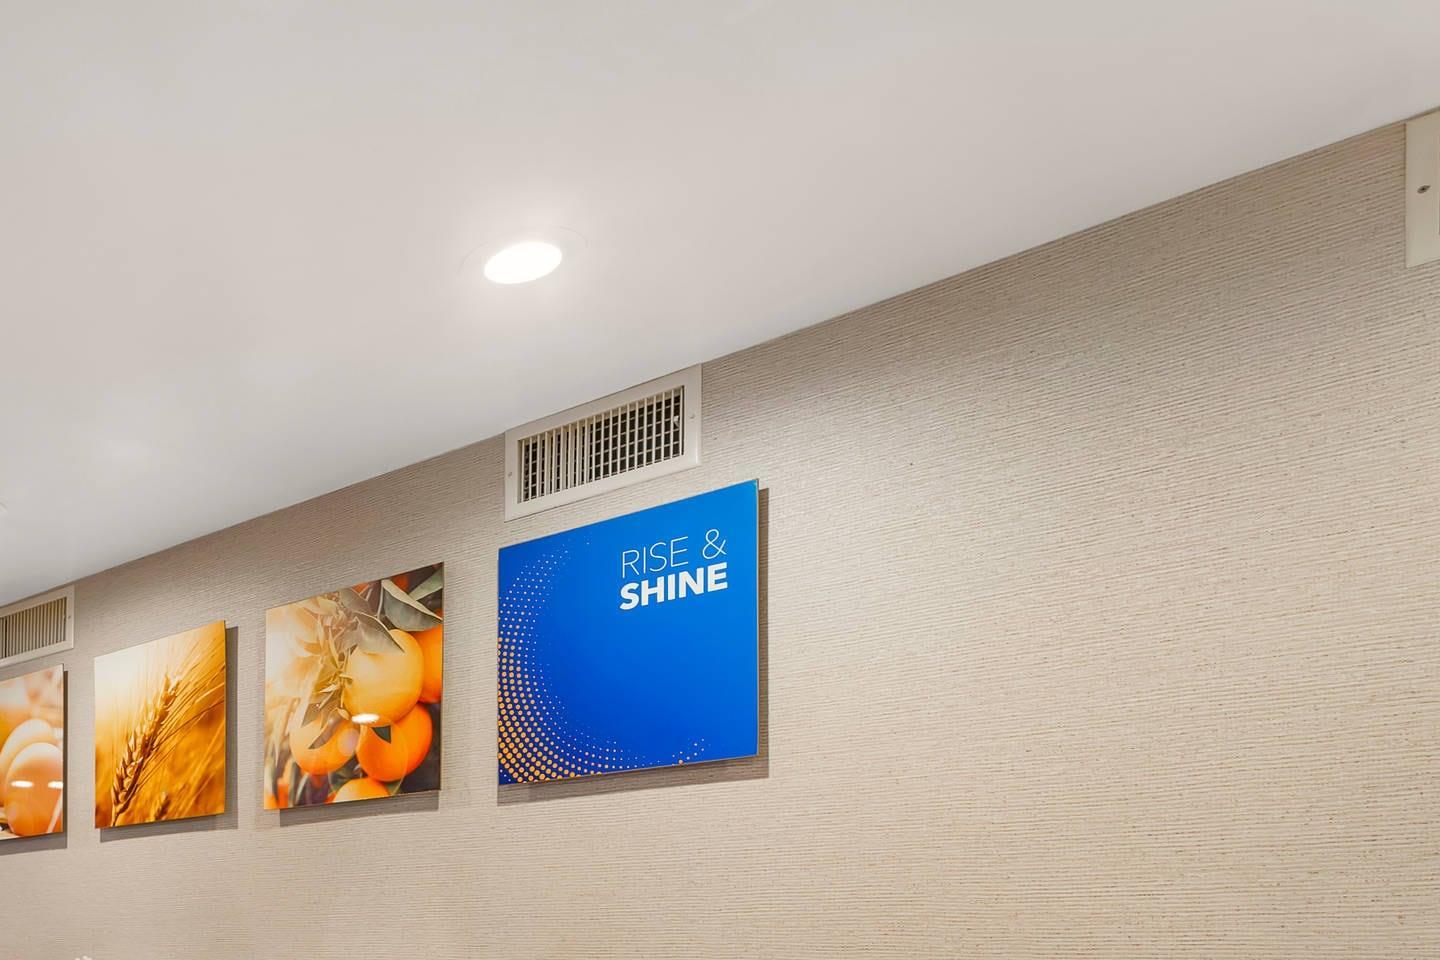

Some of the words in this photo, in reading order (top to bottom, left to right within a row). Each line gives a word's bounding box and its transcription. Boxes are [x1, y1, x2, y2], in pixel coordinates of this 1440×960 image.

[622, 536, 689, 579] RISE
[702, 528, 727, 560] &
[619, 562, 728, 610] SHINE
